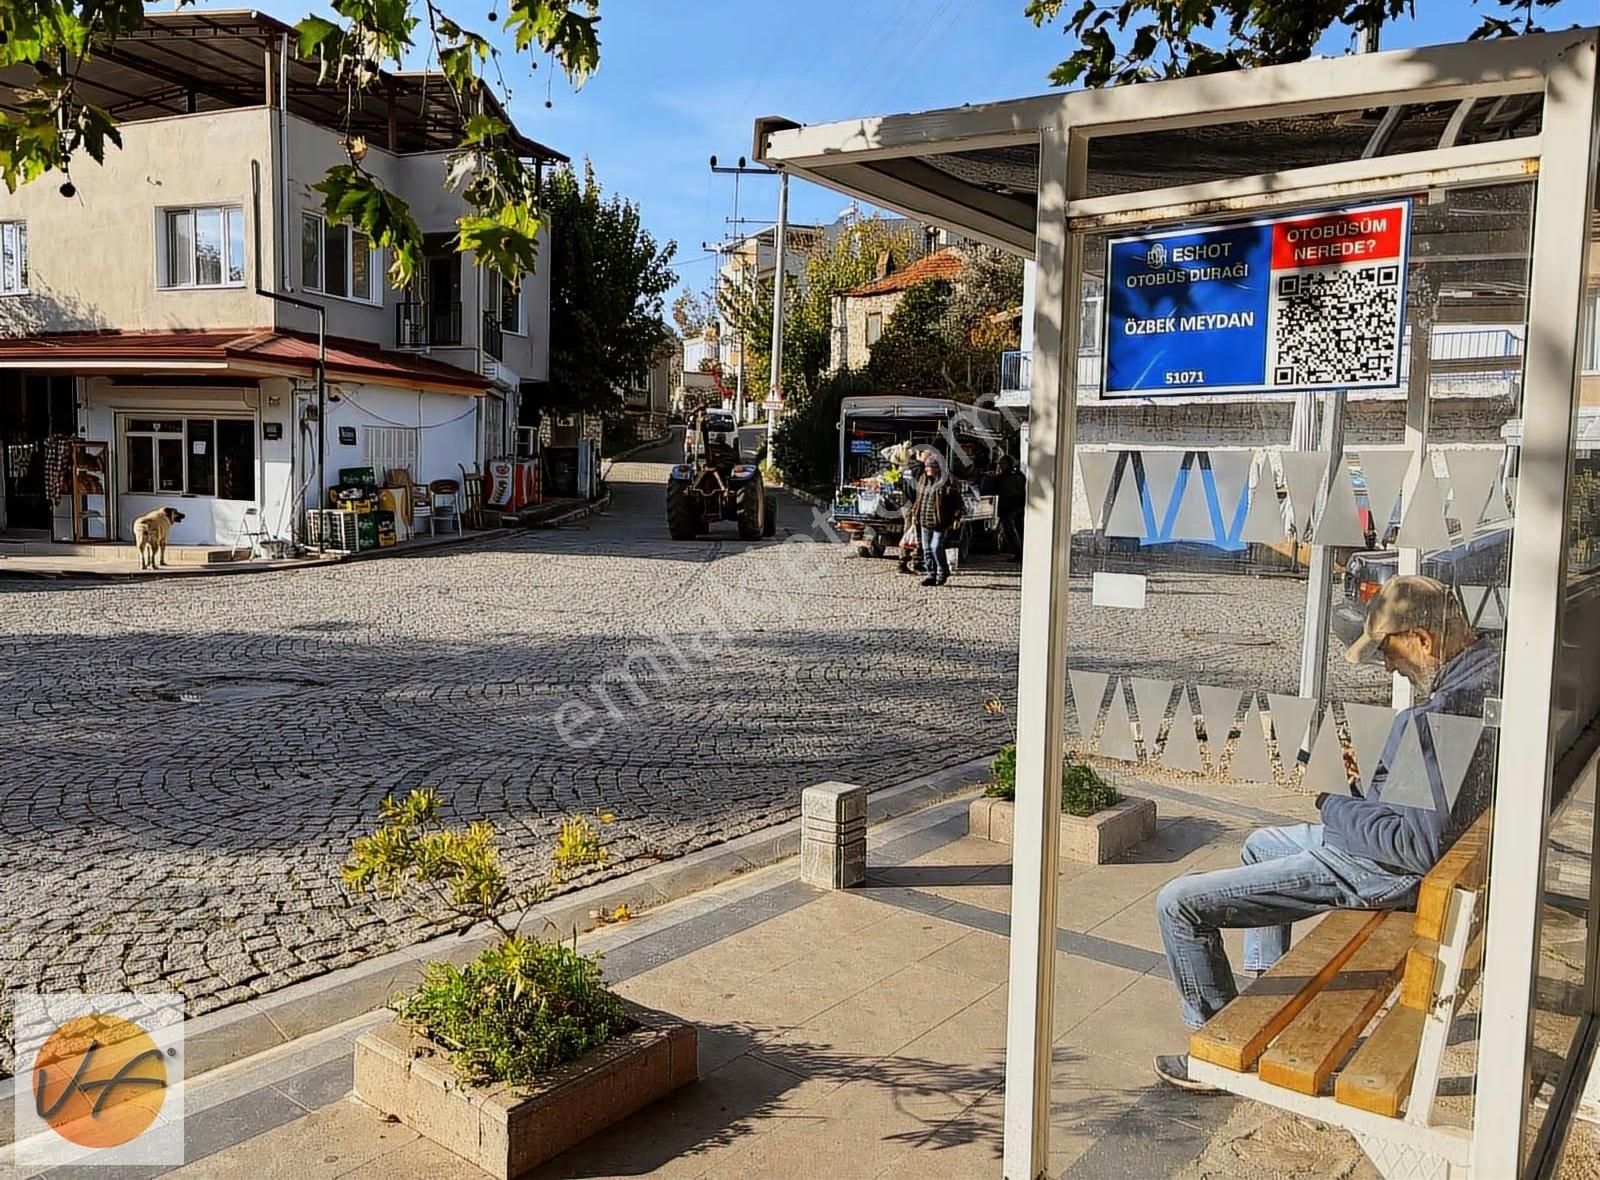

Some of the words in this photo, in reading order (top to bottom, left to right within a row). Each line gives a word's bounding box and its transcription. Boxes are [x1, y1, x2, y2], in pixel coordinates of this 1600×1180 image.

[1287, 217, 1387, 243] OTOBÜSÜM
[1172, 243, 1233, 263] ESHOT
[1294, 239, 1377, 261] NEREDE?
[1126, 269, 1186, 288] OTOBÜS
[1189, 262, 1249, 283] DURAĞI
[1124, 317, 1177, 336] ÖZBEK
[1179, 311, 1255, 332] MEYDAN
[1164, 370, 1205, 385] 51071
